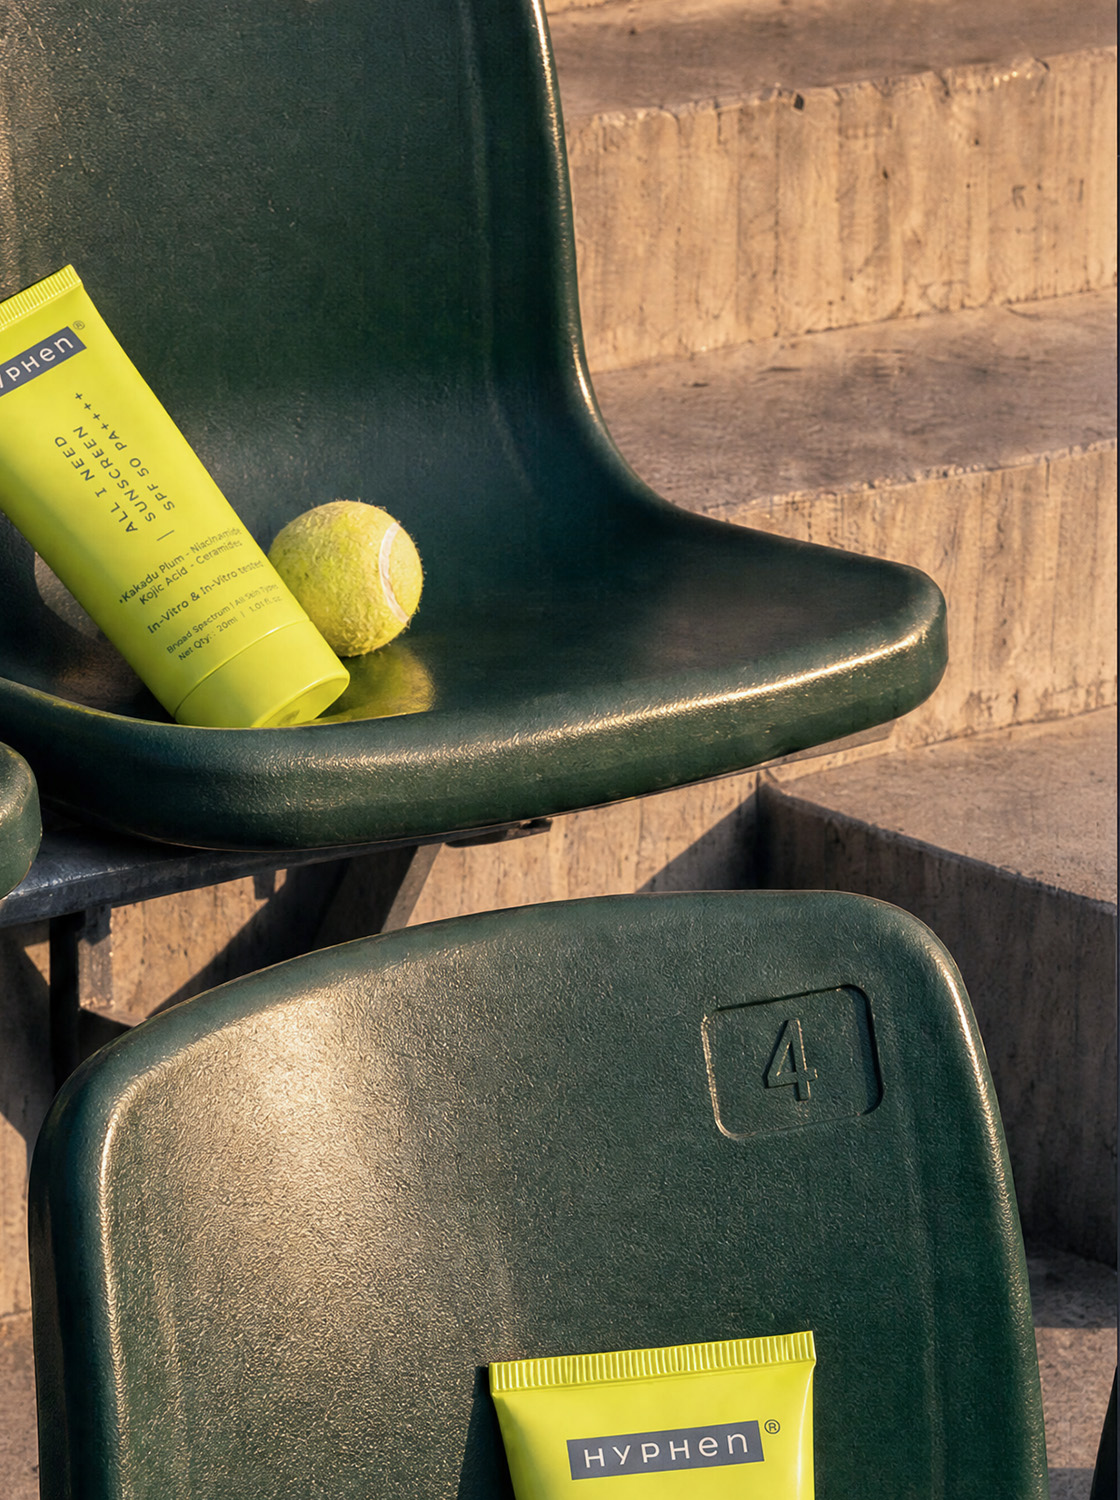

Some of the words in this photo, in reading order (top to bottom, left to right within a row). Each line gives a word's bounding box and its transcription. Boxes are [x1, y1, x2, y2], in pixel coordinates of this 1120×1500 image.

[55, 437, 95, 481] NEED
[73, 426, 156, 522] SUNSCREEN
[129, 458, 149, 477] 50
[95, 487, 107, 497] I
[147, 484, 175, 511] SPF
[111, 502, 138, 532] ALL
[158, 555, 185, 573] Plum
[147, 600, 189, 633] In-Vitro
[190, 592, 200, 601] &
[200, 571, 238, 595] In-Vitro
[762, 1017, 818, 1102] 4
